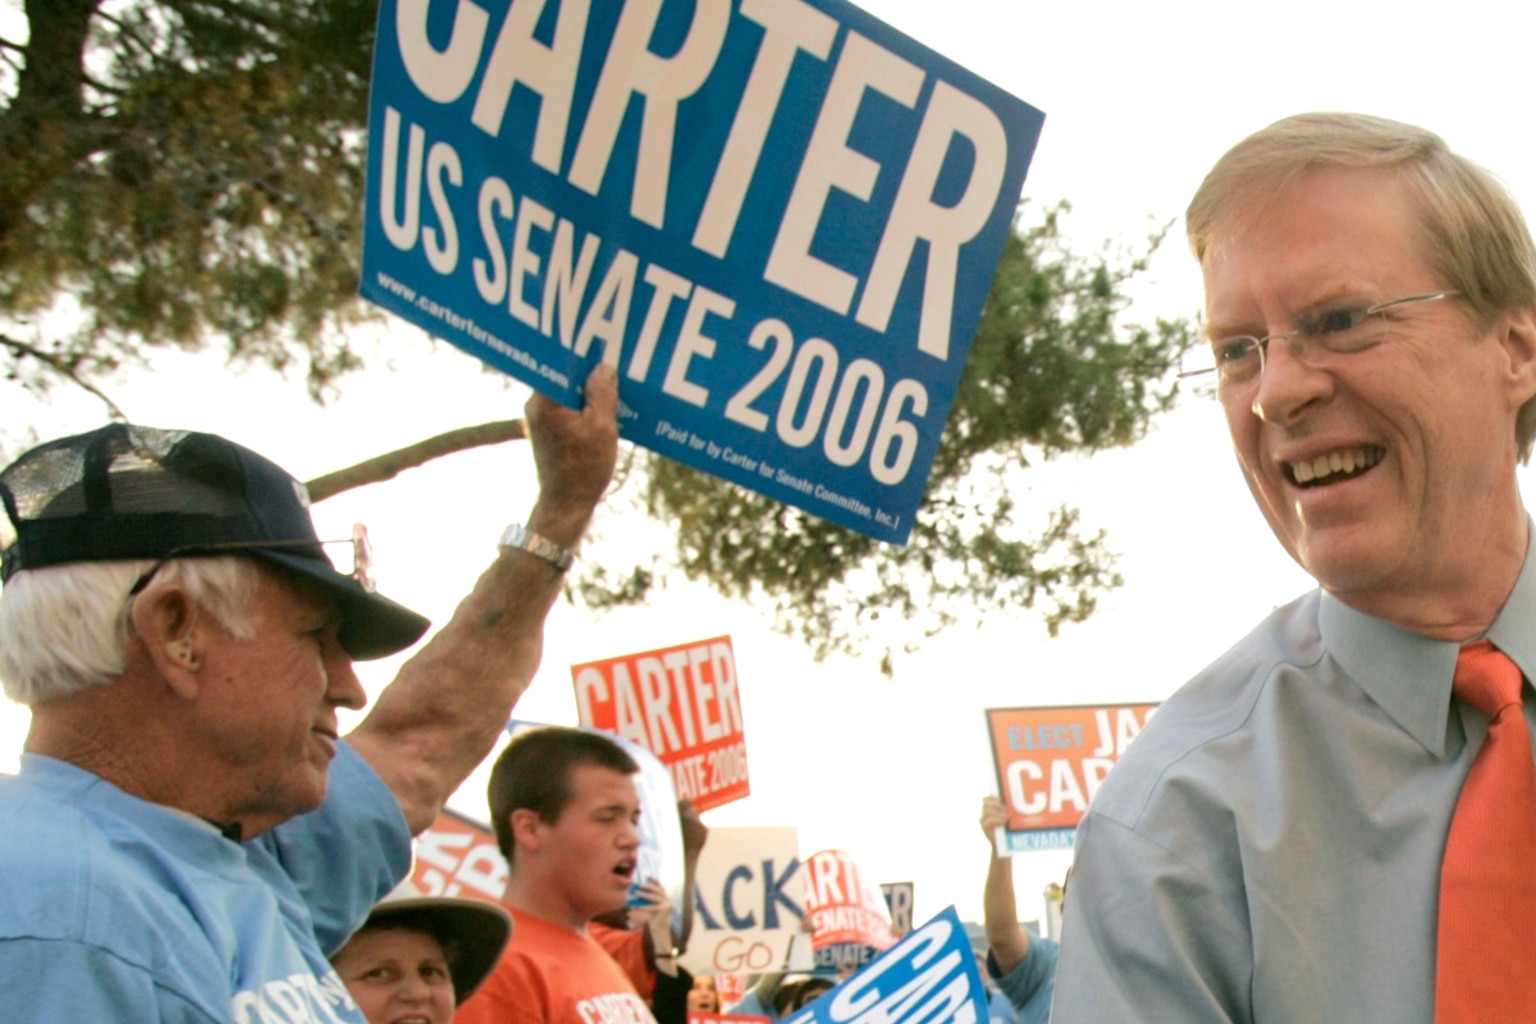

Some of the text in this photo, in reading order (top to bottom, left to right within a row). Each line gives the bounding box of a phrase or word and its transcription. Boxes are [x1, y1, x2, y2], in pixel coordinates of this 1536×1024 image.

[377, 271, 570, 389] www.carterfornevada.com
[380, 106, 928, 485] US SENATE 2006
[689, 433, 704, 451] for
[707, 441, 722, 459] by
[722, 448, 757, 472] Carter
[759, 461, 775, 478] for
[776, 468, 813, 495] Senate
[576, 642, 744, 756] CARTER
[1008, 707, 1159, 757] ELECT JA
[708, 742, 748, 792] 2006
